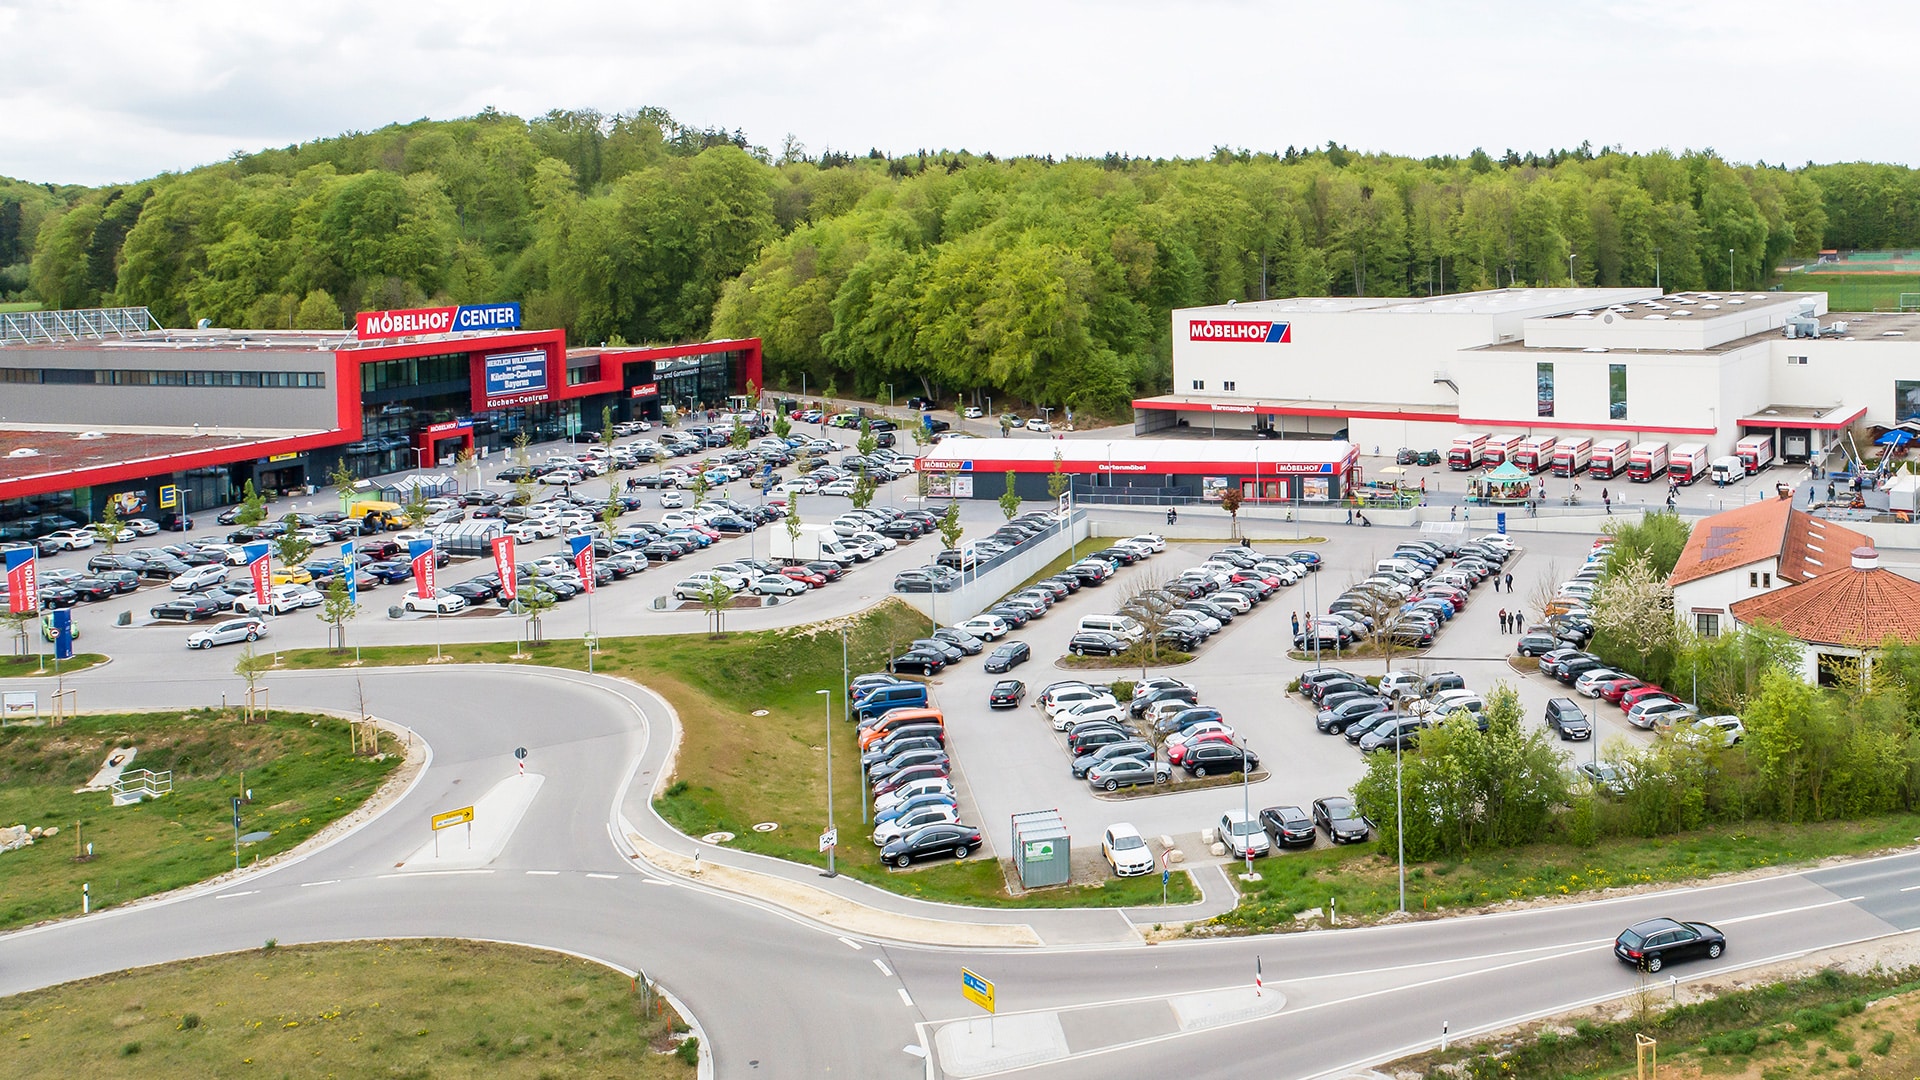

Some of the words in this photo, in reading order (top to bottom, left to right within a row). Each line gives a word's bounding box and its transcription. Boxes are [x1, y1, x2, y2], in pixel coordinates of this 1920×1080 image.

[366, 312, 449, 334] MÖBELHOF
[460, 307, 514, 326] CENTER
[1191, 320, 1267, 338] MÖBELHOF
[1211, 404, 1255, 412] Warenausgabe
[1279, 463, 1319, 472] MÖBELHOF
